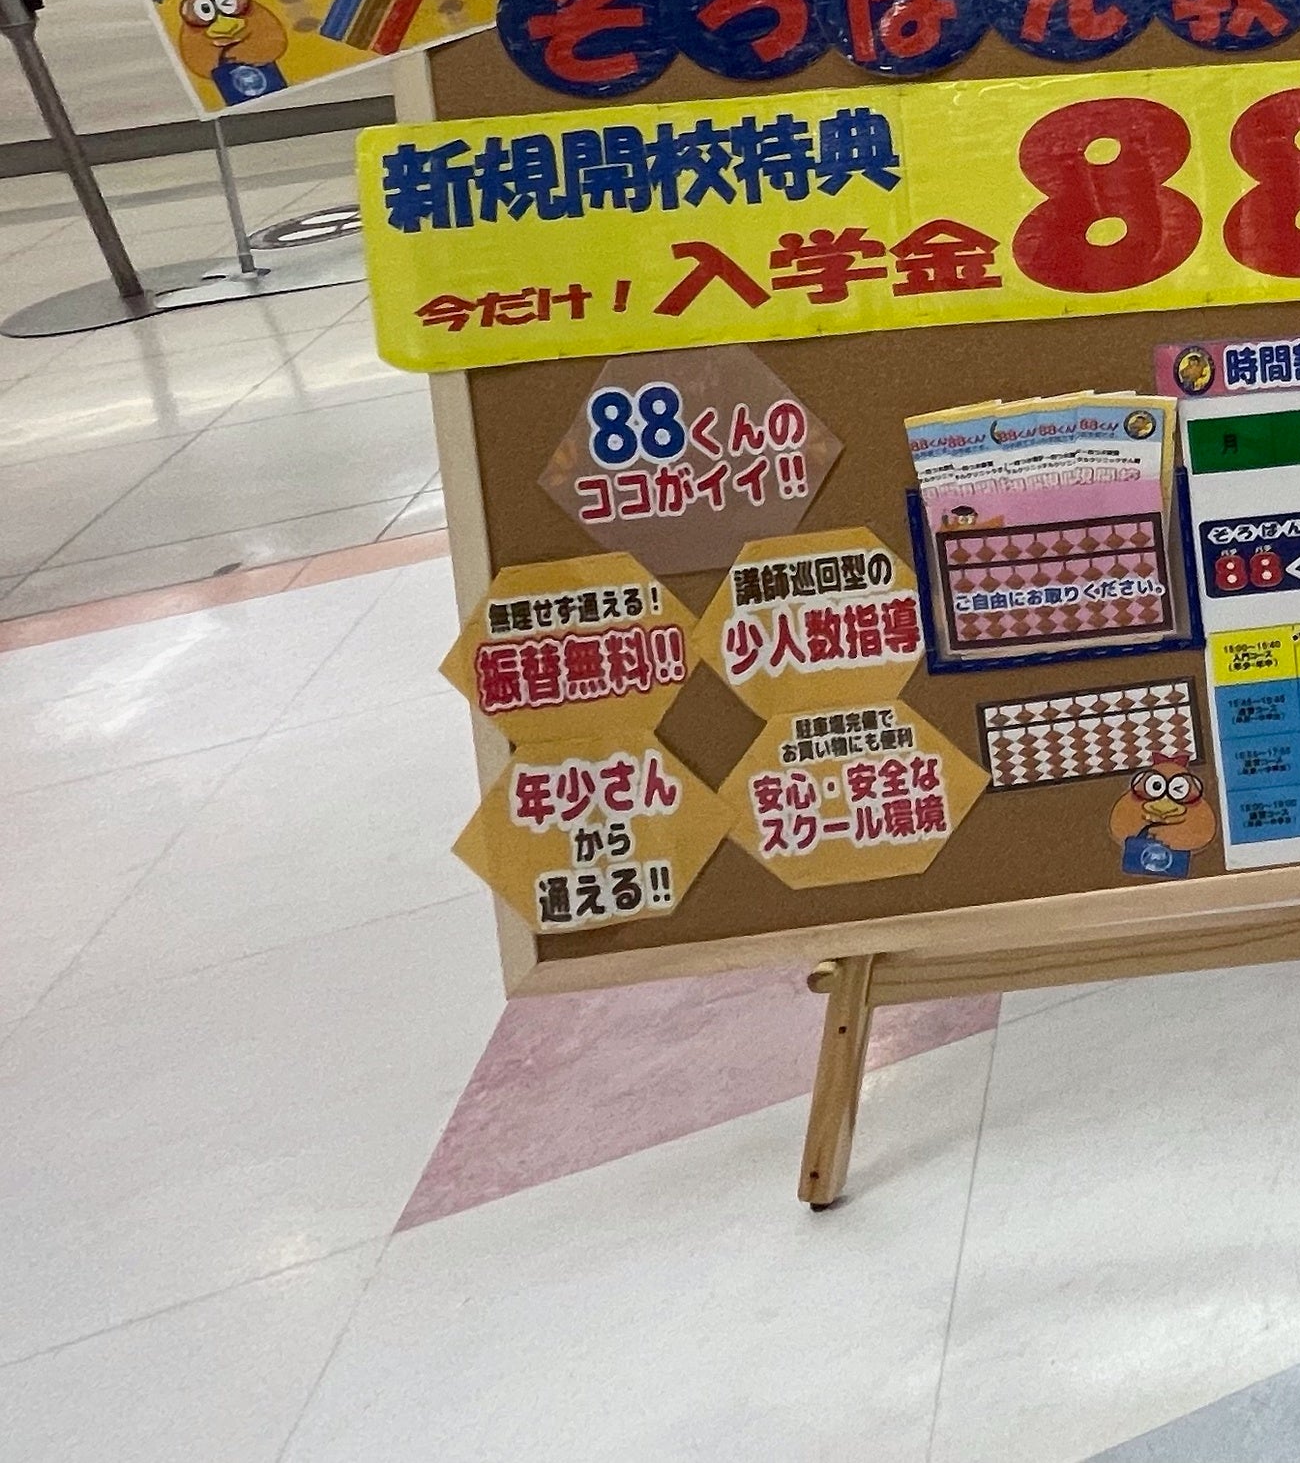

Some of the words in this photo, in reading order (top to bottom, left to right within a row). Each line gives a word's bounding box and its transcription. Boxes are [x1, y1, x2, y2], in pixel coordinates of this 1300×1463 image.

[382, 108, 902, 233] 新規開校特典
[416, 280, 634, 334] 今だけ!
[588, 385, 808, 466] 88くんの
[1079, 418, 1120, 433] 88くん
[1222, 433, 1239, 453] 月
[576, 456, 808, 522] ココがイイ!!
[733, 552, 893, 607] 講師巡回型の
[955, 578, 1166, 613] ご自由にお取りください。
[489, 586, 660, 634] 無理せず通える!
[725, 598, 920, 677] 少人数指導
[479, 626, 686, 710] 振替無料!!
[515, 757, 677, 825] 年少さん
[753, 757, 941, 815] 安心・安全な
[573, 822, 632, 863] から
[760, 794, 948, 853] スクール環境
[538, 865, 673, 924] 通える!!
